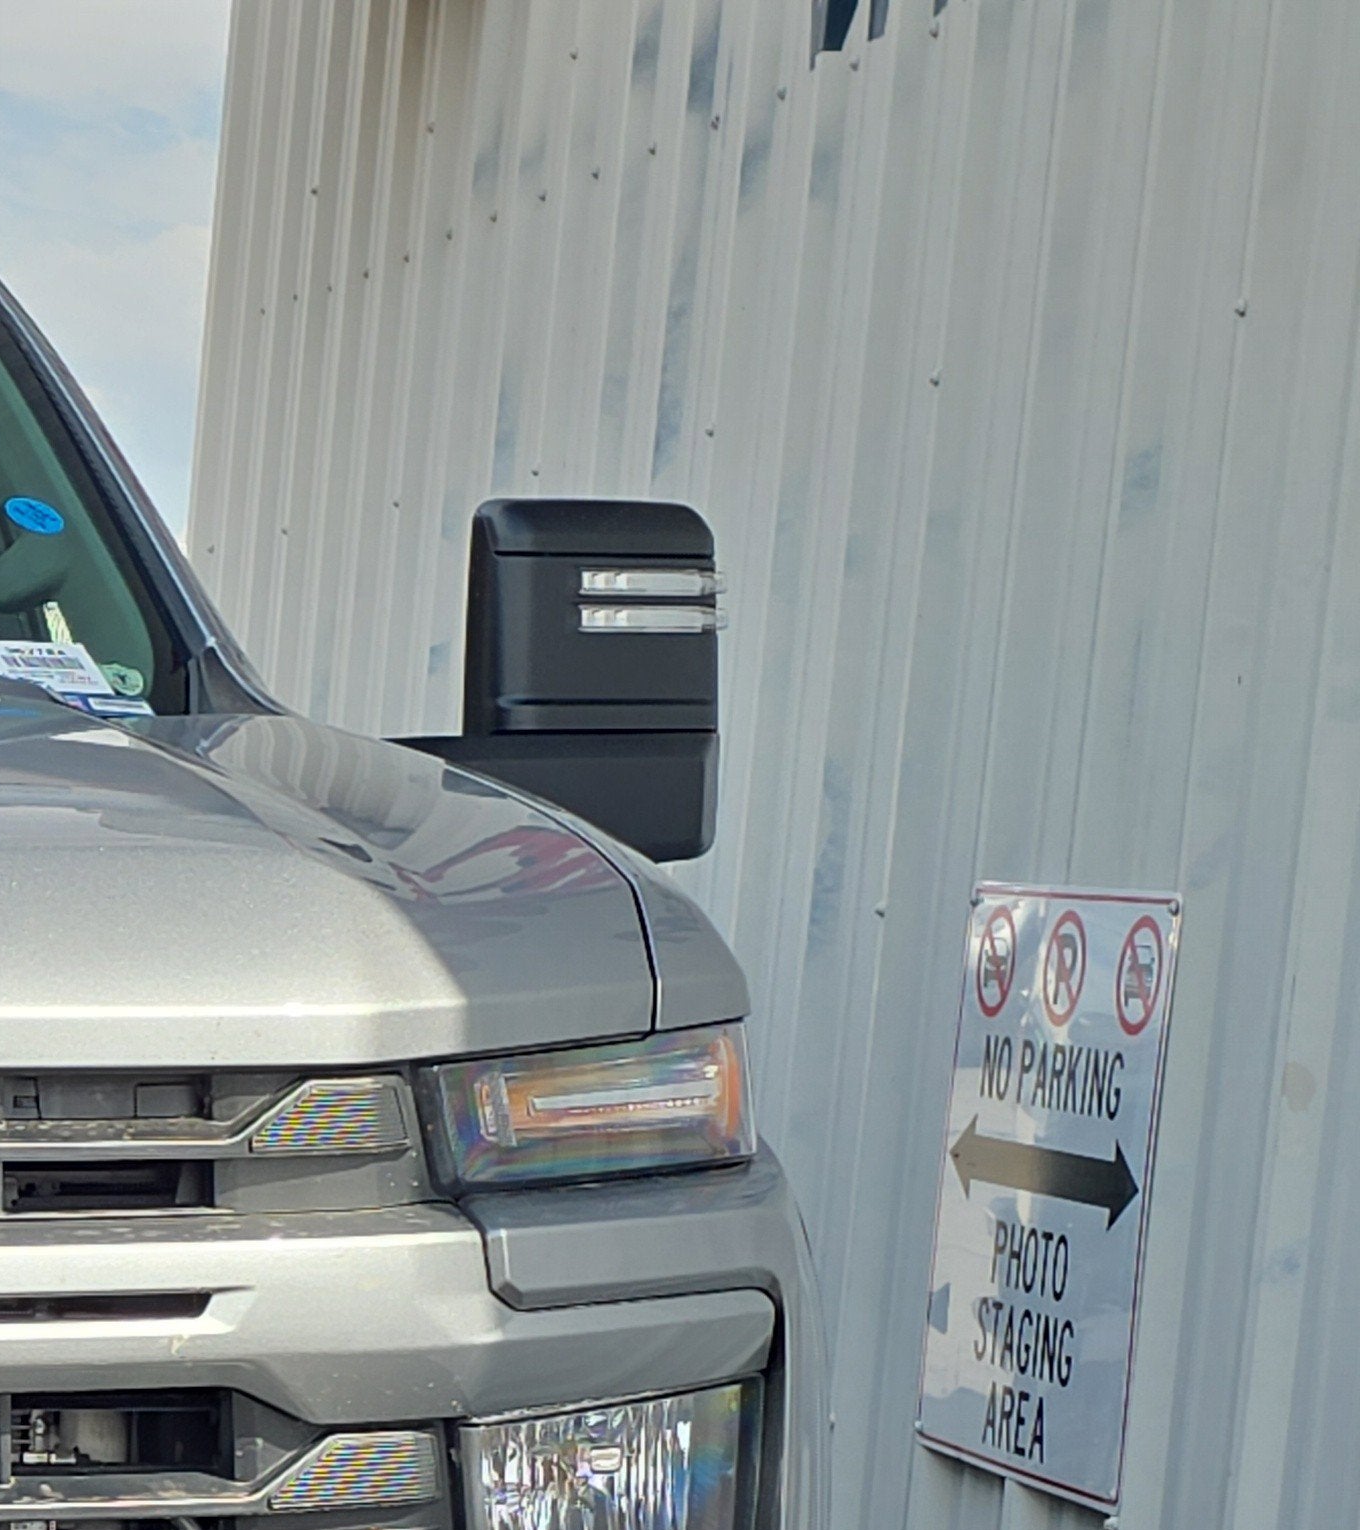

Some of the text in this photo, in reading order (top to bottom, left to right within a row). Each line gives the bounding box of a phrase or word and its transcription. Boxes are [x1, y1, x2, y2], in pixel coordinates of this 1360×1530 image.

[980, 1034, 1124, 1120] NO PARKING
[991, 1219, 1068, 1301] PHOTO
[974, 1297, 1074, 1387] STAGING
[982, 1381, 1044, 1464] AREA
